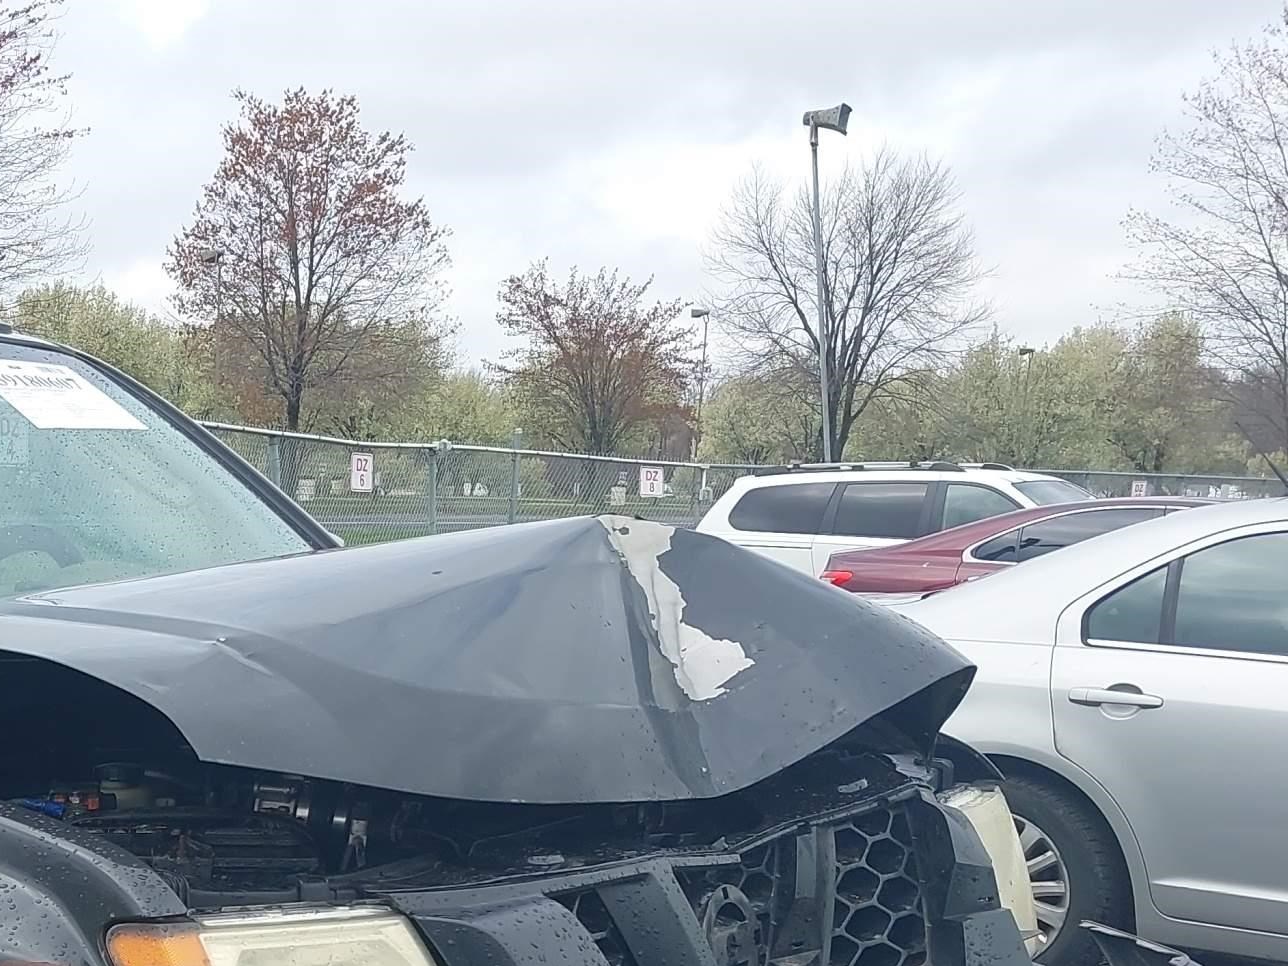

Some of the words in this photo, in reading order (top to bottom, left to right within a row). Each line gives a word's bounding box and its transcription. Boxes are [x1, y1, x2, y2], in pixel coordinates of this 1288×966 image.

[356, 457, 369, 472] DZ
[359, 473, 365, 487] 6
[645, 470, 659, 481] DZ
[649, 481, 655, 492] 8
